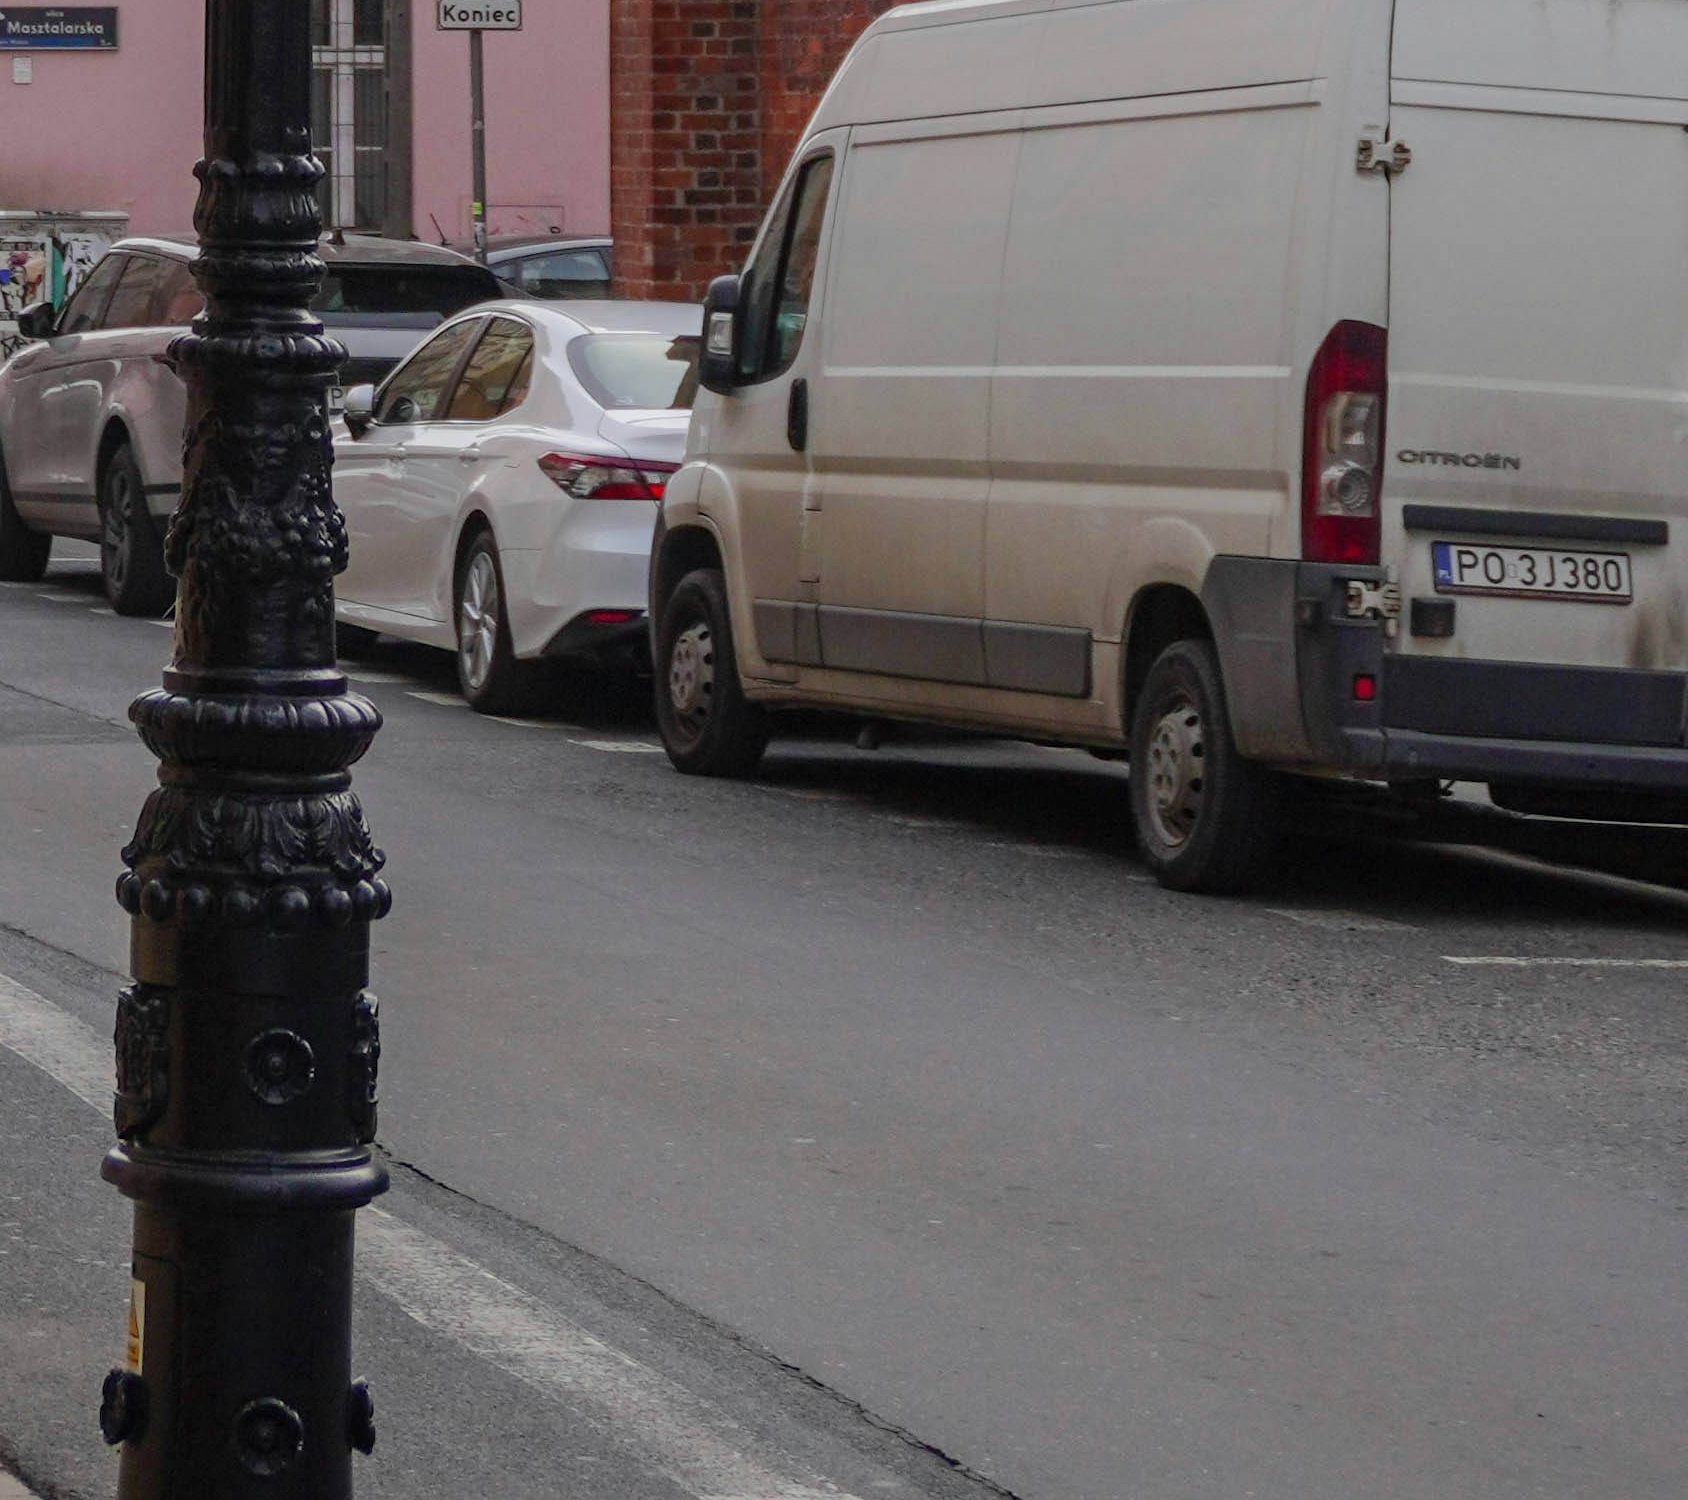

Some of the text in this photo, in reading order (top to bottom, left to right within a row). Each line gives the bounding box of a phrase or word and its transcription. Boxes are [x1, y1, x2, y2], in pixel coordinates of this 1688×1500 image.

[443, 4, 516, 22] Koniec
[6, 21, 105, 35] Masztalarska
[330, 387, 345, 407] P
[1396, 448, 1521, 471] CITROËN
[1456, 548, 1623, 593] PO 3J380
